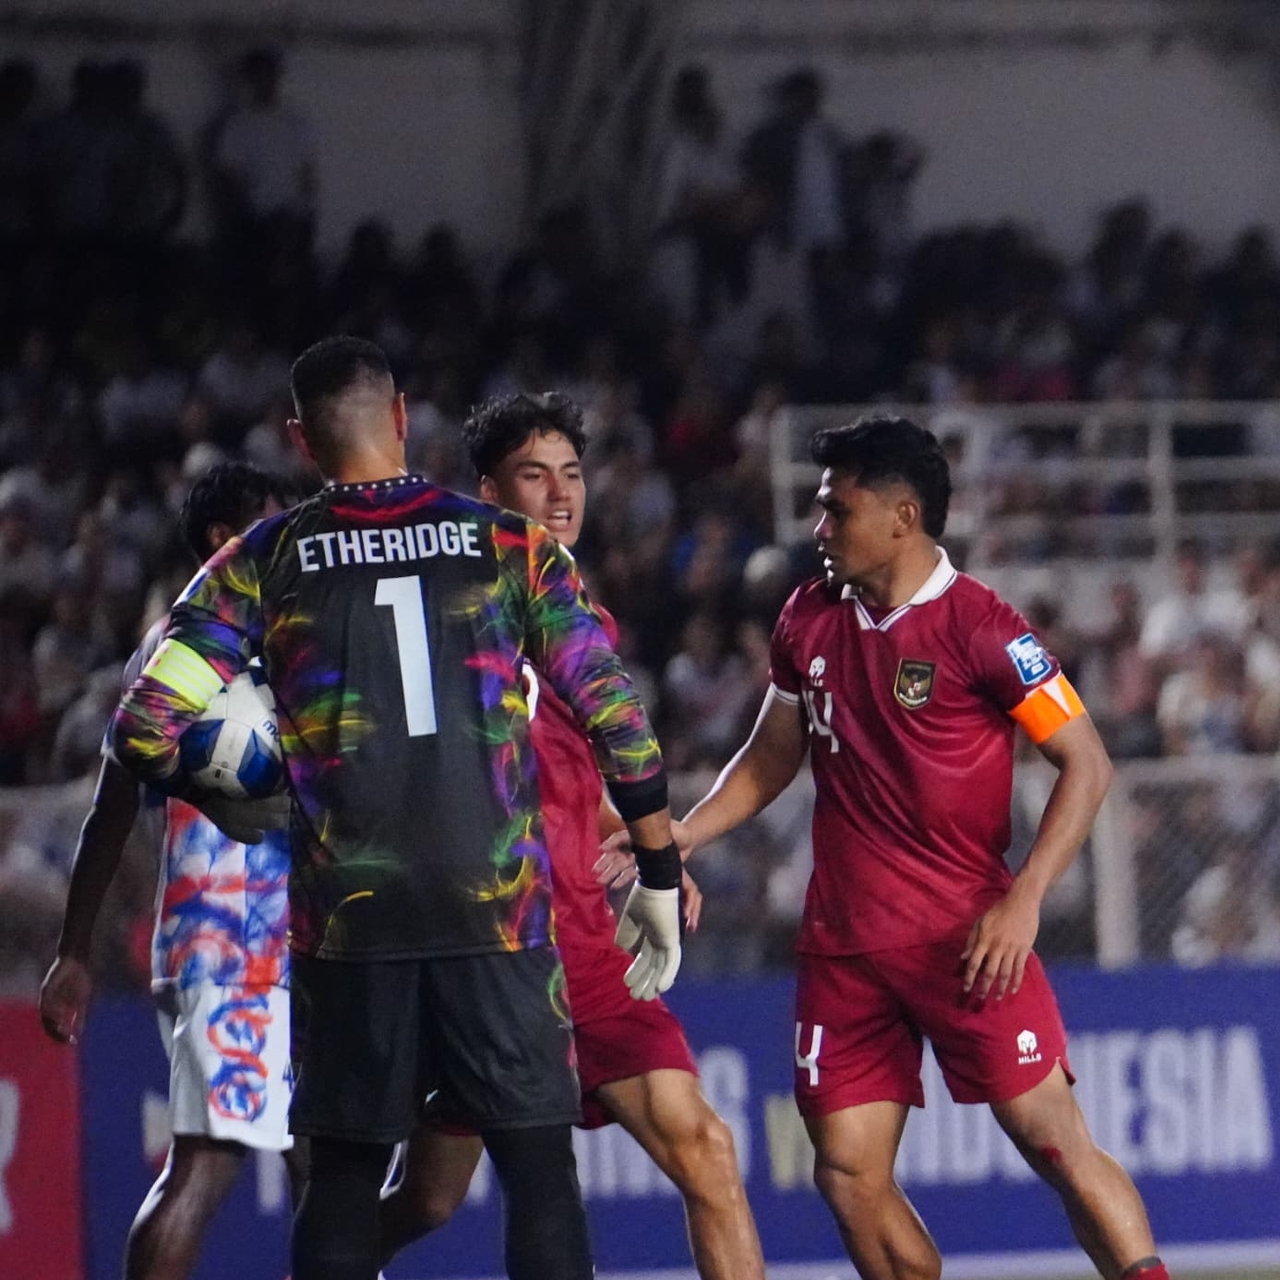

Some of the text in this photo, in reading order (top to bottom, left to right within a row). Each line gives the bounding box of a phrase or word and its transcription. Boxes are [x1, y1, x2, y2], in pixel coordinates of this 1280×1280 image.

[296, 521, 482, 572] ETHERIDGE
[375, 575, 437, 737] 1
[1018, 1052, 1042, 1066] MILLS
